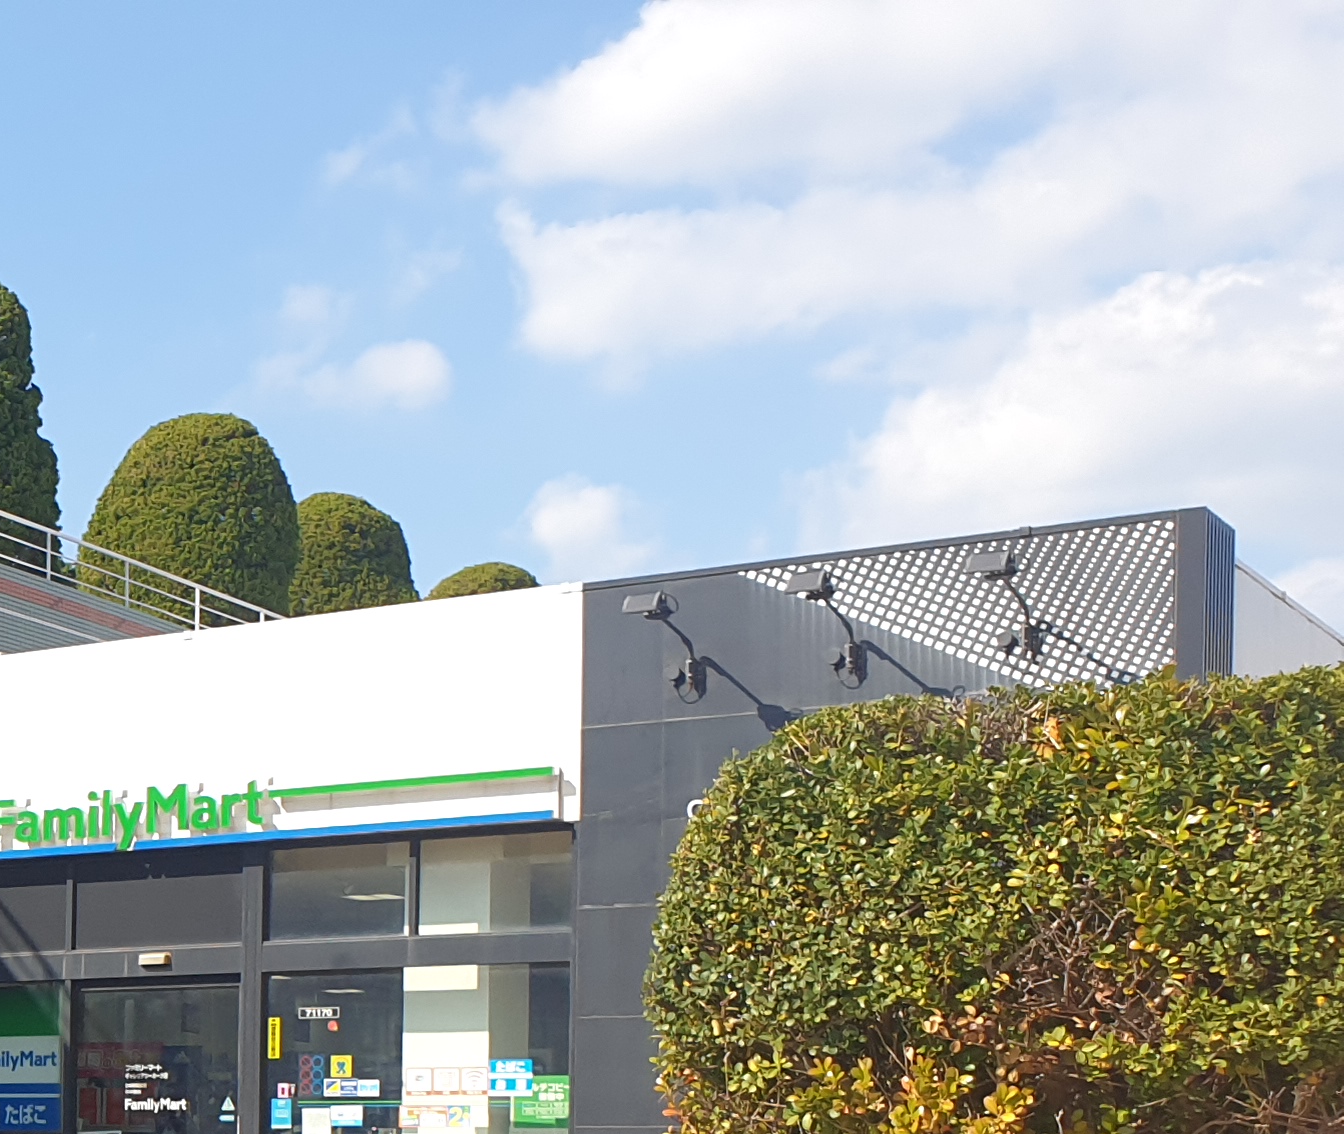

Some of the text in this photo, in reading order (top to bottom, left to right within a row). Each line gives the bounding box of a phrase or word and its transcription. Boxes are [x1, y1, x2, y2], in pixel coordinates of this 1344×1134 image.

[4, 1104, 47, 1125] たばこ
[124, 1097, 187, 1114] FamilyMart
